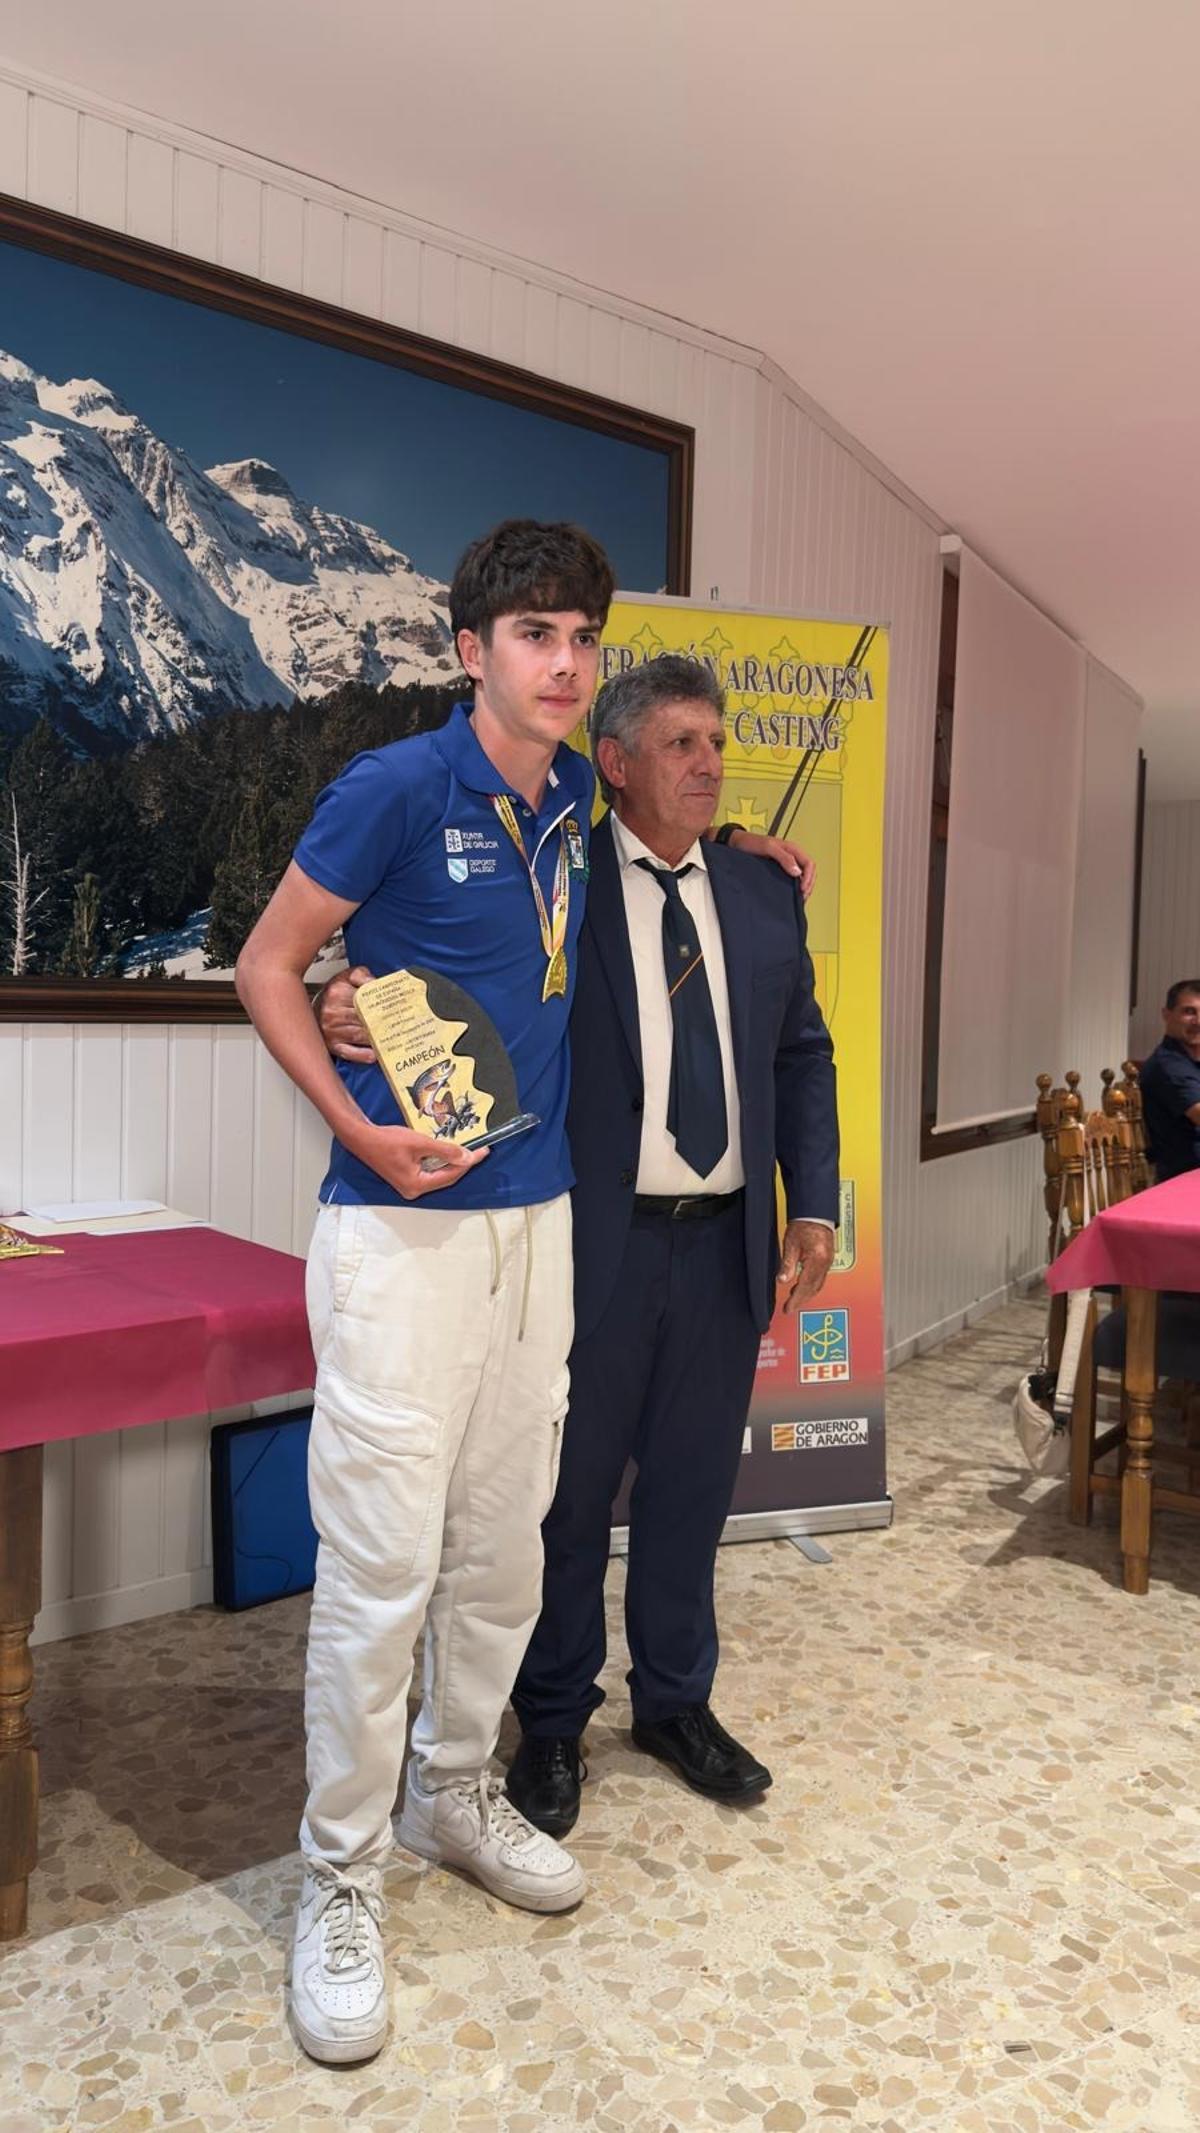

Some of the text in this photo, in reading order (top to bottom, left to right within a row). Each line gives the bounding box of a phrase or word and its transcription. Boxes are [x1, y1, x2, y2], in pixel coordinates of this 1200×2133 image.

[724, 659, 874, 700] ARAGONESA
[734, 711, 840, 750] CASTING
[461, 832, 484, 840] XUNTA
[463, 841, 499, 849] DE GALICIA
[395, 1045, 445, 1072] CAMPEÓN
[803, 1364, 847, 1381] FEP
[796, 1421, 859, 1435] GOBIERNO
[796, 1432, 868, 1448] DE ARAGON
